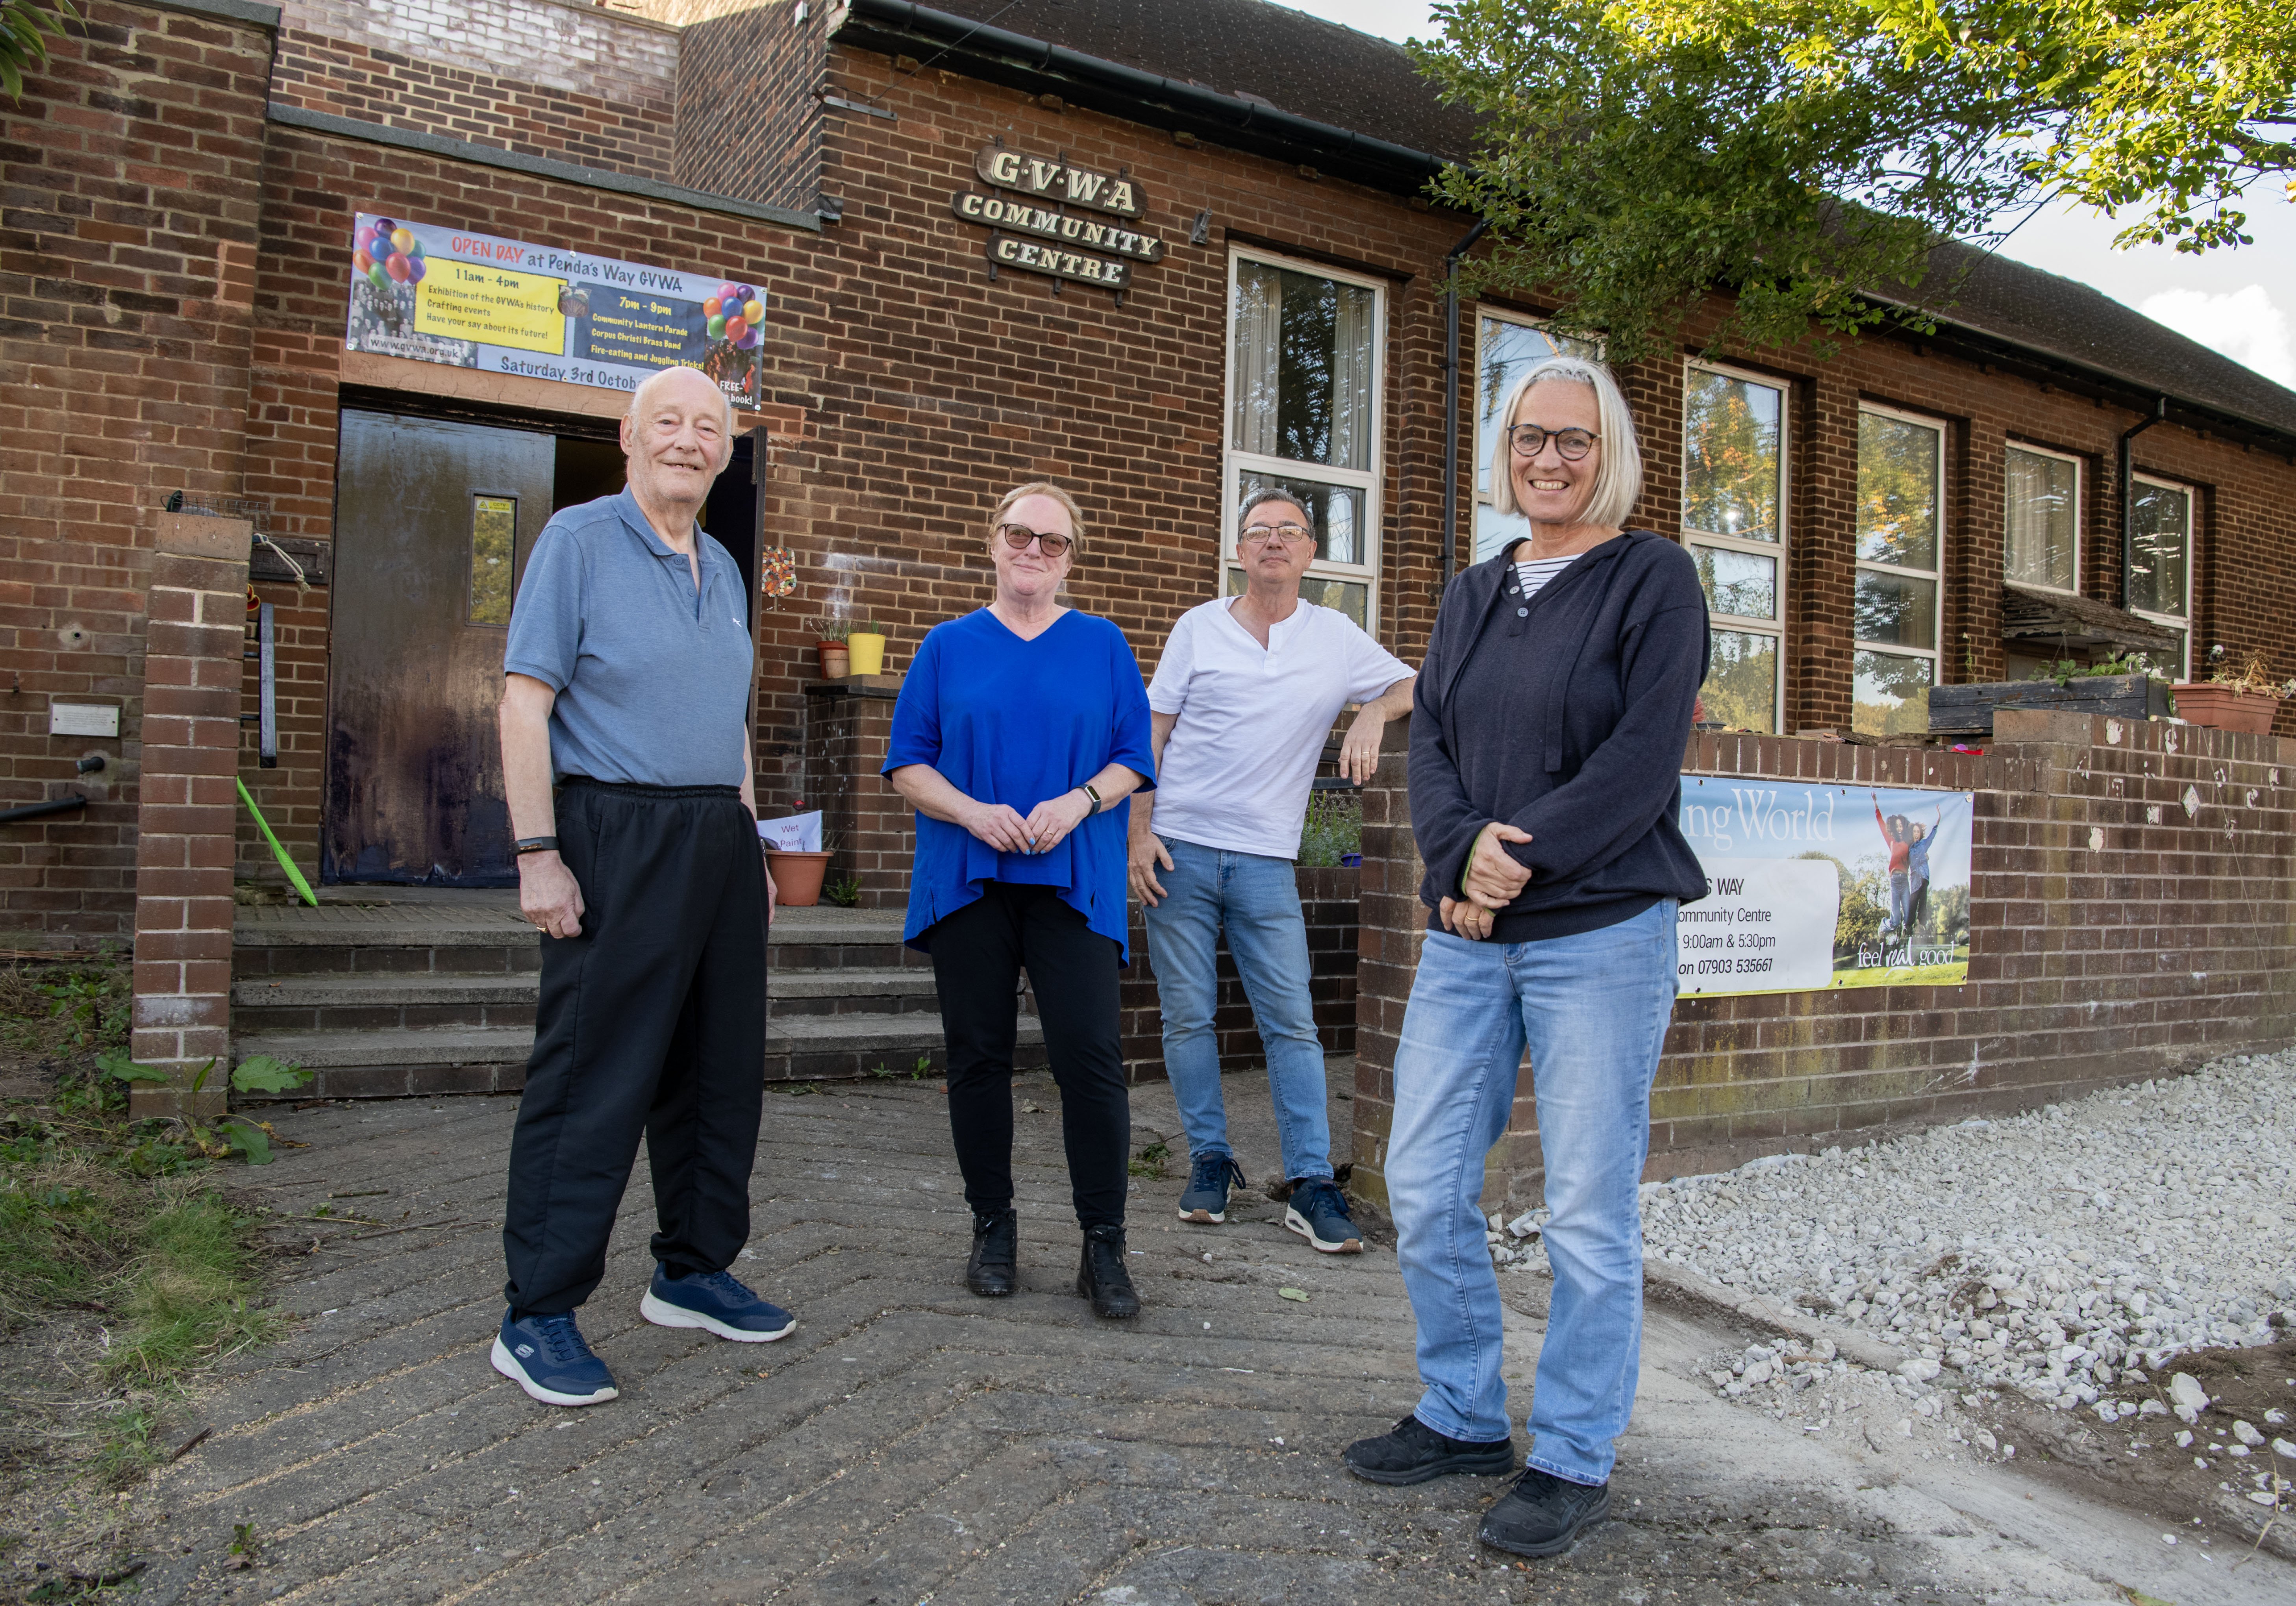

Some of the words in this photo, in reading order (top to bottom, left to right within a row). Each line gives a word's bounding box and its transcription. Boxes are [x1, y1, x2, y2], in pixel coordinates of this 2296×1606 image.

[963, 194, 1158, 256] COMMUNITY
[452, 236, 491, 258] OPEN
[496, 245, 524, 263] DAY
[528, 254, 544, 267] at
[549, 254, 598, 277] Penda's
[603, 264, 635, 286] Way
[639, 272, 683, 293] GVWA
[998, 239, 1123, 283] CENTRE
[496, 276, 519, 289] 4pm
[427, 299, 462, 313] Crafting
[464, 307, 491, 317] events
[428, 285, 468, 299] Exhibition
[470, 293, 479, 301] of
[481, 294, 494, 303] the
[526, 300, 554, 314] history
[619, 296, 640, 311] 7pm
[650, 302, 672, 315] 9pm
[427, 313, 446, 323] Have
[447, 318, 465, 327] your
[468, 320, 481, 330] say
[483, 323, 506, 333] about
[508, 326, 518, 335] its
[520, 328, 548, 339] future!
[592, 313, 633, 328] Community
[635, 320, 663, 333] Lantern
[665, 326, 688, 337] Parade
[370, 339, 459, 358] www.gvwa.org.uk
[591, 328, 616, 339] Corpus
[617, 332, 642, 343] Christi
[643, 337, 663, 347] Brass
[664, 340, 681, 350] Band
[591, 345, 632, 360] Fire-eating
[634, 350, 648, 361] and
[650, 354, 679, 367] Juggling
[681, 359, 704, 370] Tricks!
[501, 356, 566, 382] Saturday
[571, 367, 594, 383] 3rd
[598, 370, 641, 390] Octob
[720, 380, 743, 392] FREE-
[731, 393, 752, 406] book!
[255, 553, 309, 566] LETTRS
[781, 824, 799, 833] Wet
[780, 838, 802, 847] Paint
[1717, 878, 1744, 895] WAY
[1678, 907, 1734, 926] ommunity
[1737, 908, 1771, 922] Centre
[1683, 934, 1723, 948] 9:00am
[1726, 934, 1735, 948] &
[1739, 934, 1776, 951] 5:30pm
[1857, 942, 1884, 967] feel
[1886, 937, 1915, 967] real
[1918, 940, 1955, 971] good
[1678, 963, 1694, 974] on
[1698, 959, 1732, 974] 07903
[1736, 958, 1773, 973] 535661
